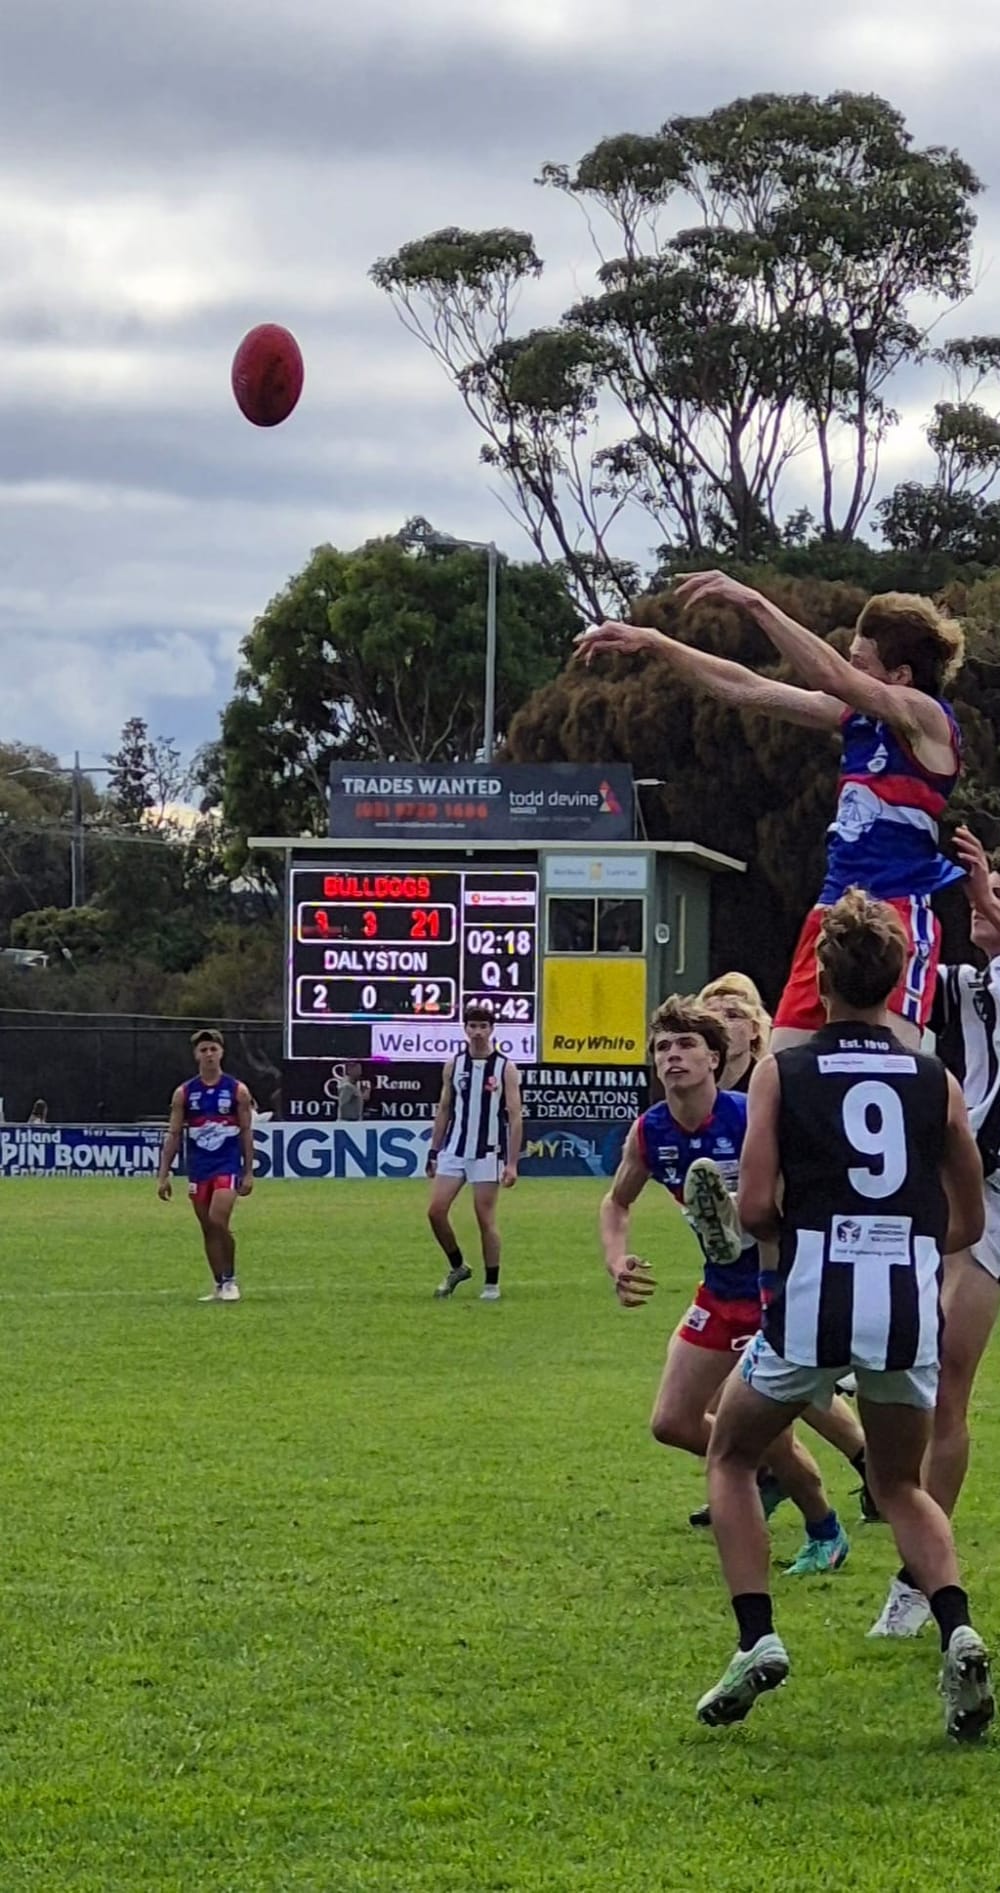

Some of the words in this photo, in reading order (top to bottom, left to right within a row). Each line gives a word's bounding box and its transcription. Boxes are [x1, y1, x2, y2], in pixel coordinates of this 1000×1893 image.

[342, 778, 413, 794] TRADES
[419, 778, 502, 795] WANTED
[509, 790, 544, 806] todd
[548, 790, 599, 806] devine
[323, 877, 430, 897] BULLDOGS
[363, 911, 377, 936] 3
[410, 910, 440, 937] 21
[467, 930, 530, 955] 02:18
[324, 951, 428, 972] DALYSTON
[482, 962, 500, 987] Q
[507, 963, 519, 986] 1
[313, 985, 327, 1008] 2
[362, 986, 376, 1008] 0
[411, 984, 440, 1011] 12
[380, 1033, 467, 1053] Welcom
[376, 1075, 421, 1090] Remo
[517, 1070, 648, 1087] TERRAFIRMA
[522, 1090, 639, 1104] EXCAVATIONS
[537, 1105, 639, 1118] DEMOLITION
[15, 1129, 61, 1144] Island
[842, 1080, 908, 1199] 9
